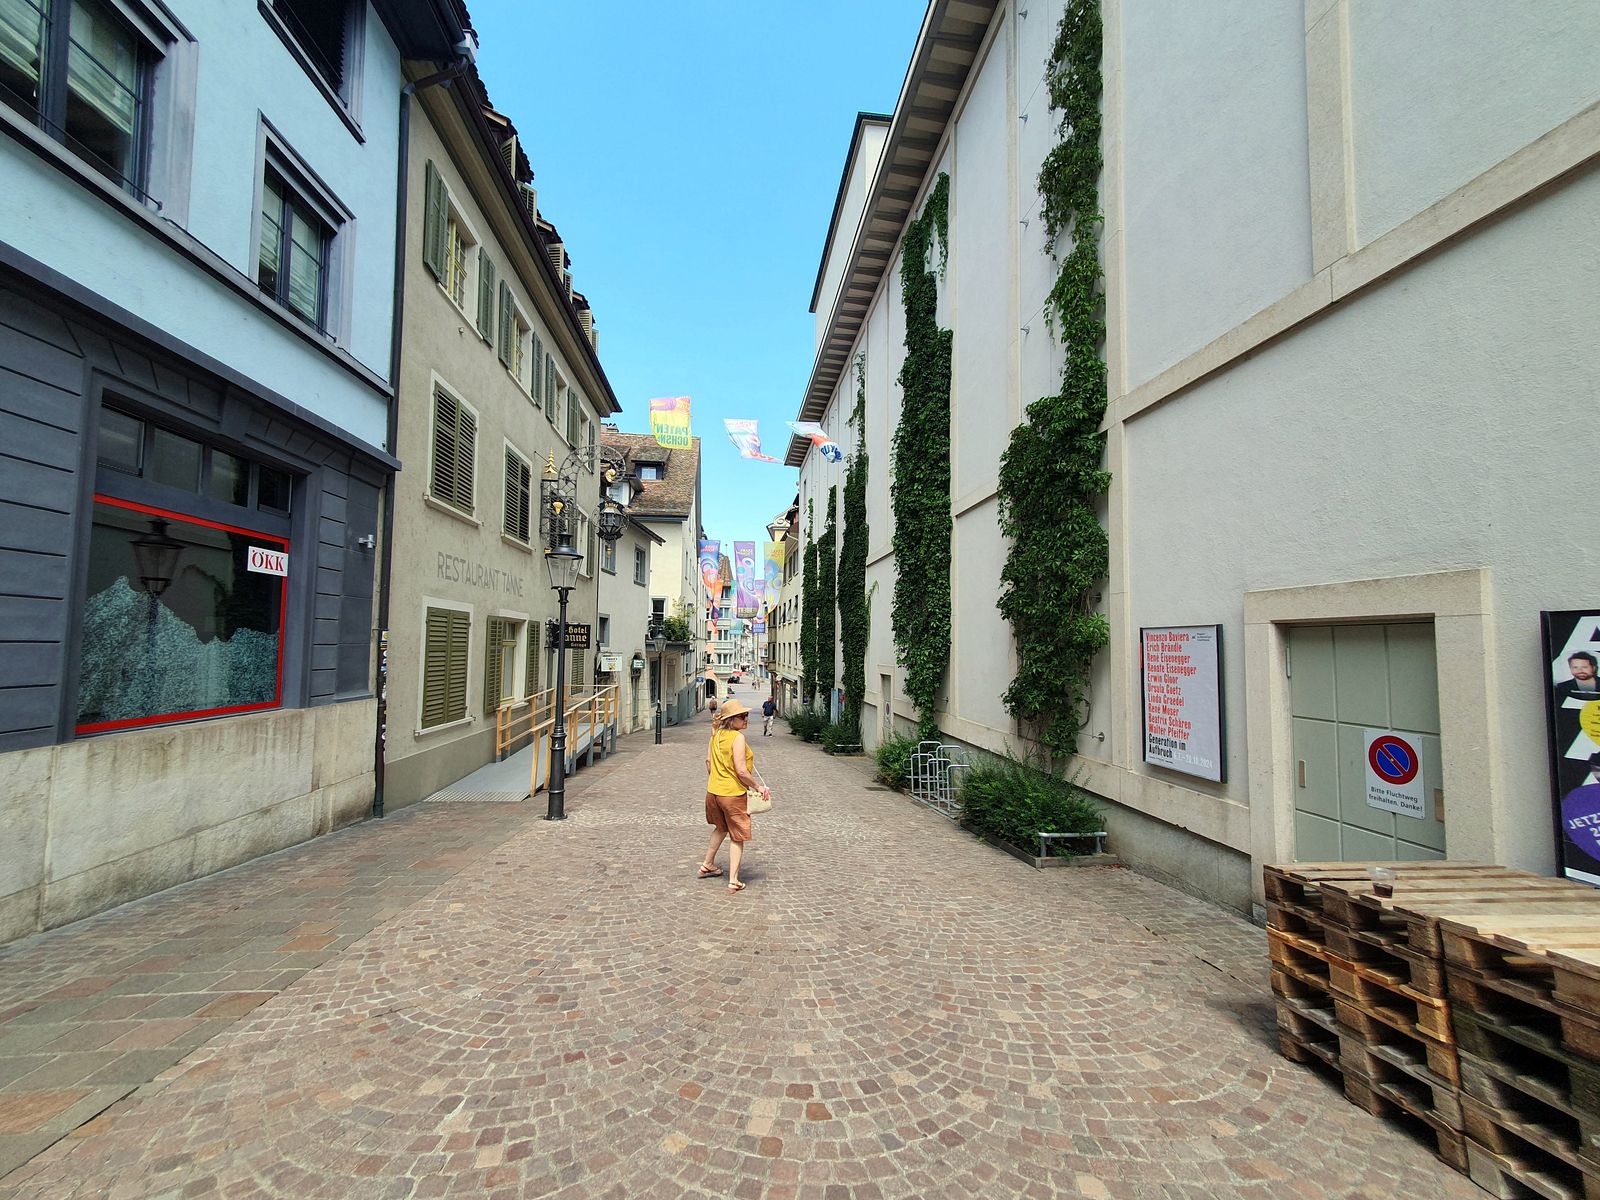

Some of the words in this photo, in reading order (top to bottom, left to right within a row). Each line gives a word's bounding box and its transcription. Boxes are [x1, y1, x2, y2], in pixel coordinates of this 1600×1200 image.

[252, 549, 284, 572] ÖKK
[437, 551, 501, 592] RESTAURANT
[565, 634, 587, 642] anne
[1147, 642, 1160, 652] Erich
[1160, 653, 1191, 665] Eisenegger
[1147, 663, 1165, 673] Renate
[1166, 663, 1197, 677] Eisenegger
[1147, 673, 1162, 683] Erwin
[1147, 683, 1164, 693] Ursula
[1148, 693, 1162, 703] Linda
[1162, 704, 1179, 716] Moser
[1148, 713, 1167, 724] Beatrix
[1148, 723, 1166, 735] Walter
[1149, 733, 1177, 749] Generation
[1179, 740, 1186, 751] im
[1149, 744, 1173, 758] Aufbruch
[1370, 786, 1385, 794] Bitte
[1386, 789, 1418, 804] Fluchtweg
[1400, 801, 1423, 812] Danke!
[1569, 812, 1600, 829] JETZ
